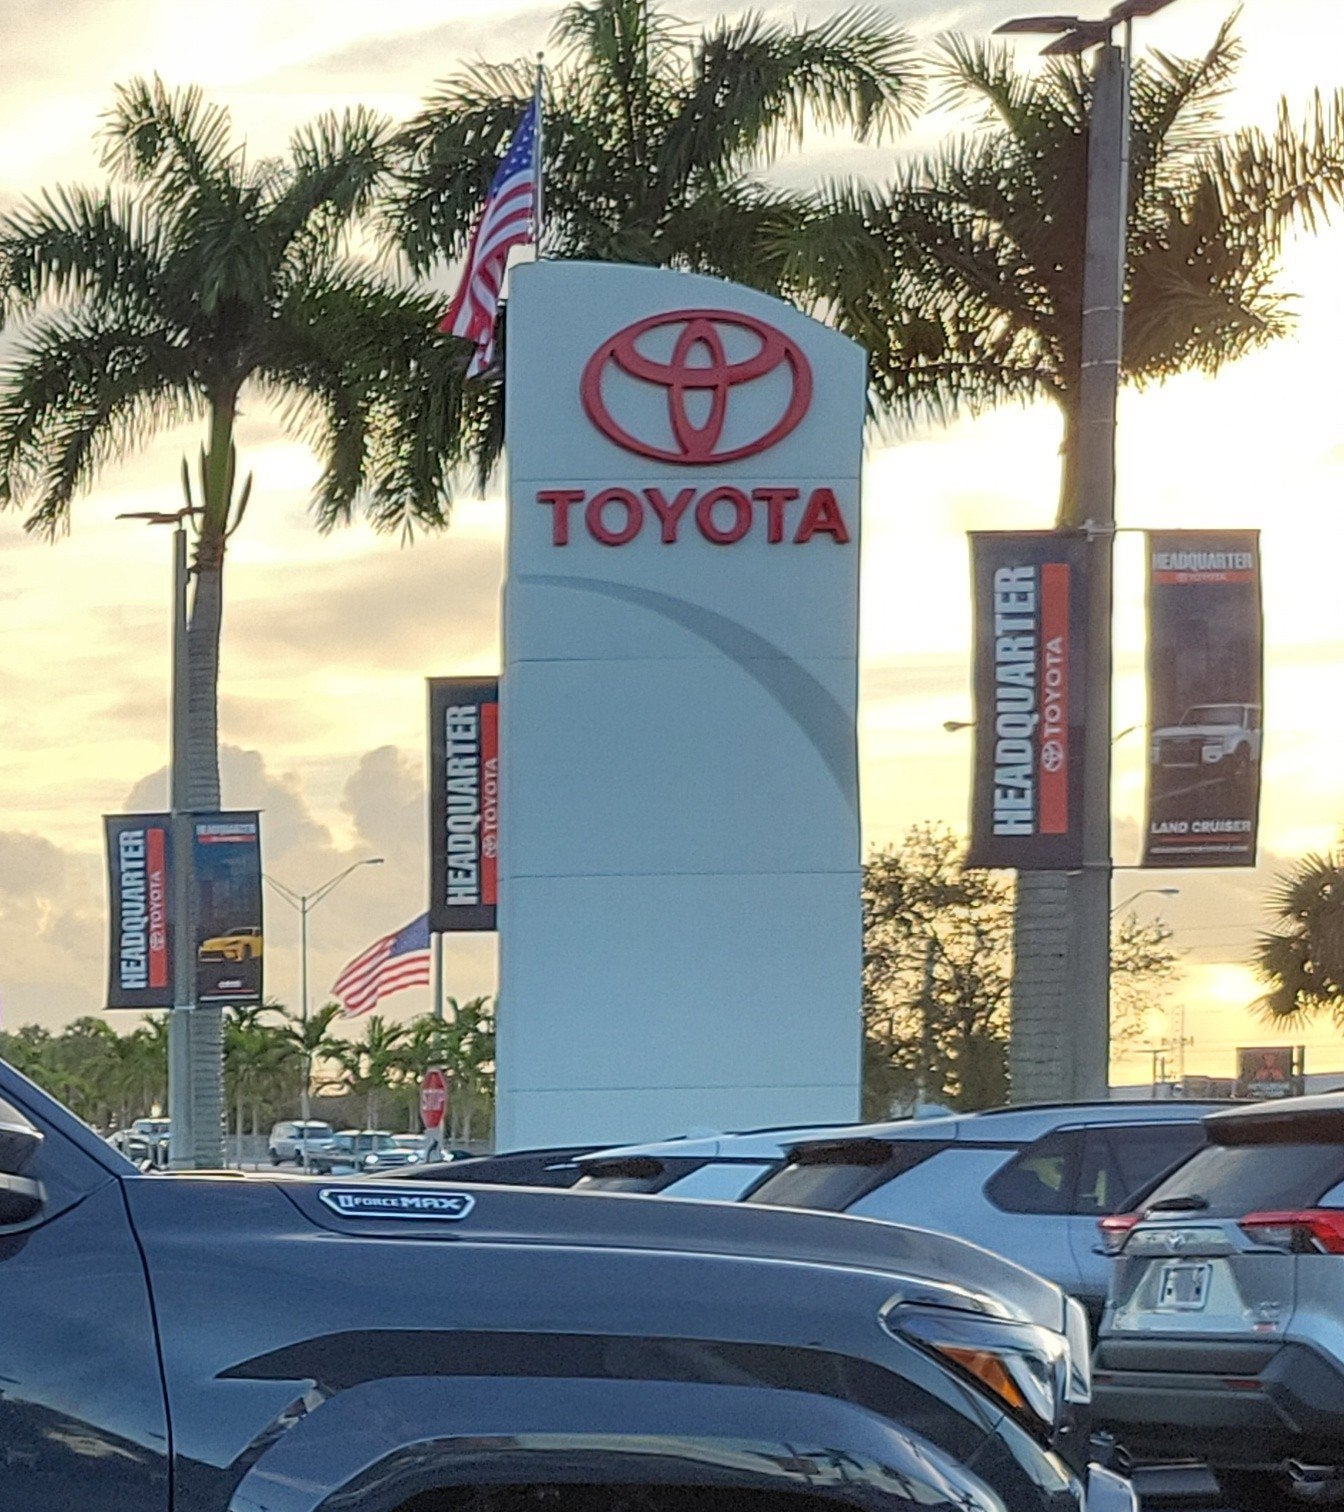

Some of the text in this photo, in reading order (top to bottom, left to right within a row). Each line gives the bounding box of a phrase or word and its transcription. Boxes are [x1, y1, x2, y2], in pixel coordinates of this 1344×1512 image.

[537, 486, 850, 547] TOYOTA
[1152, 552, 1252, 571] HEADQUARTER
[993, 565, 1038, 836] HEADQUARTER
[1044, 637, 1064, 738] TOYOTA
[446, 705, 481, 906] HEADQUARTER
[484, 757, 498, 830] TOYOTA
[1151, 820, 1251, 833] LAND CRUISER
[119, 830, 148, 989] HEADQUARTER
[149, 871, 162, 935] TOYOTA
[422, 1088, 445, 1111] STOP
[401, 1196, 462, 1209] MAX
